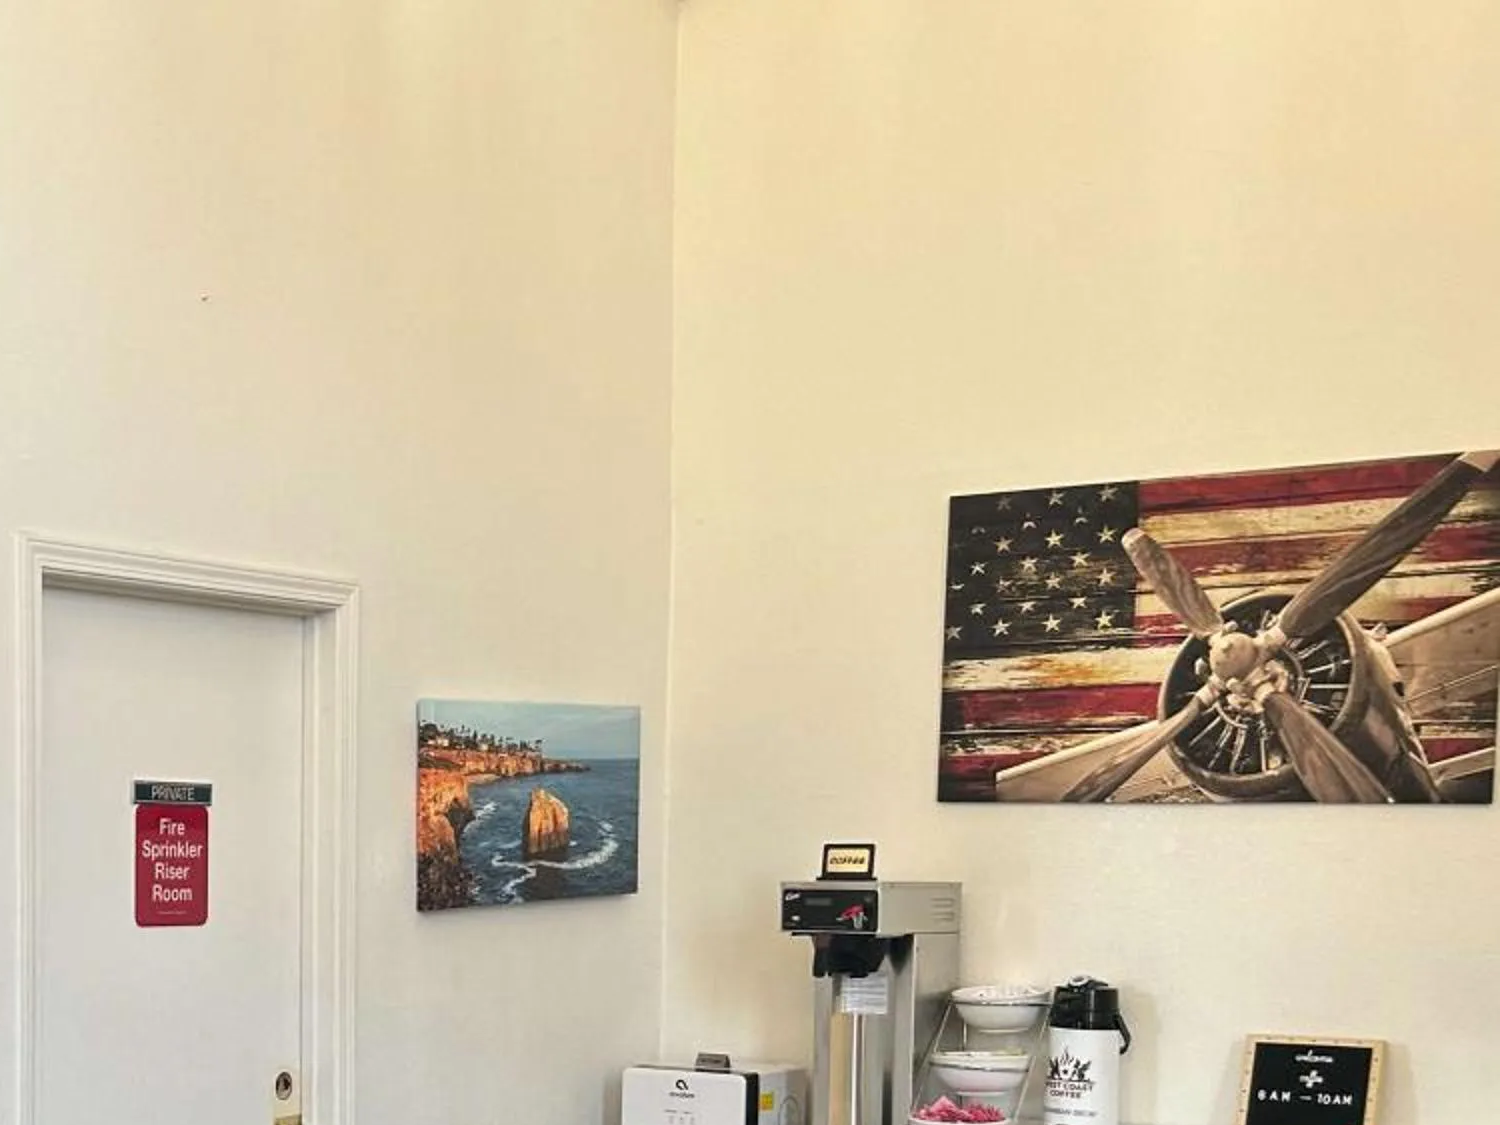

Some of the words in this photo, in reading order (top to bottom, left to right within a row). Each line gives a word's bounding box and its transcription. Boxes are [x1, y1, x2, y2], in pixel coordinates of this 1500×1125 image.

[151, 785, 195, 801] PRIVATE
[159, 817, 186, 836] Fire
[141, 839, 203, 861] Sprinkler
[155, 862, 190, 880] Riser
[152, 884, 193, 902] Room
